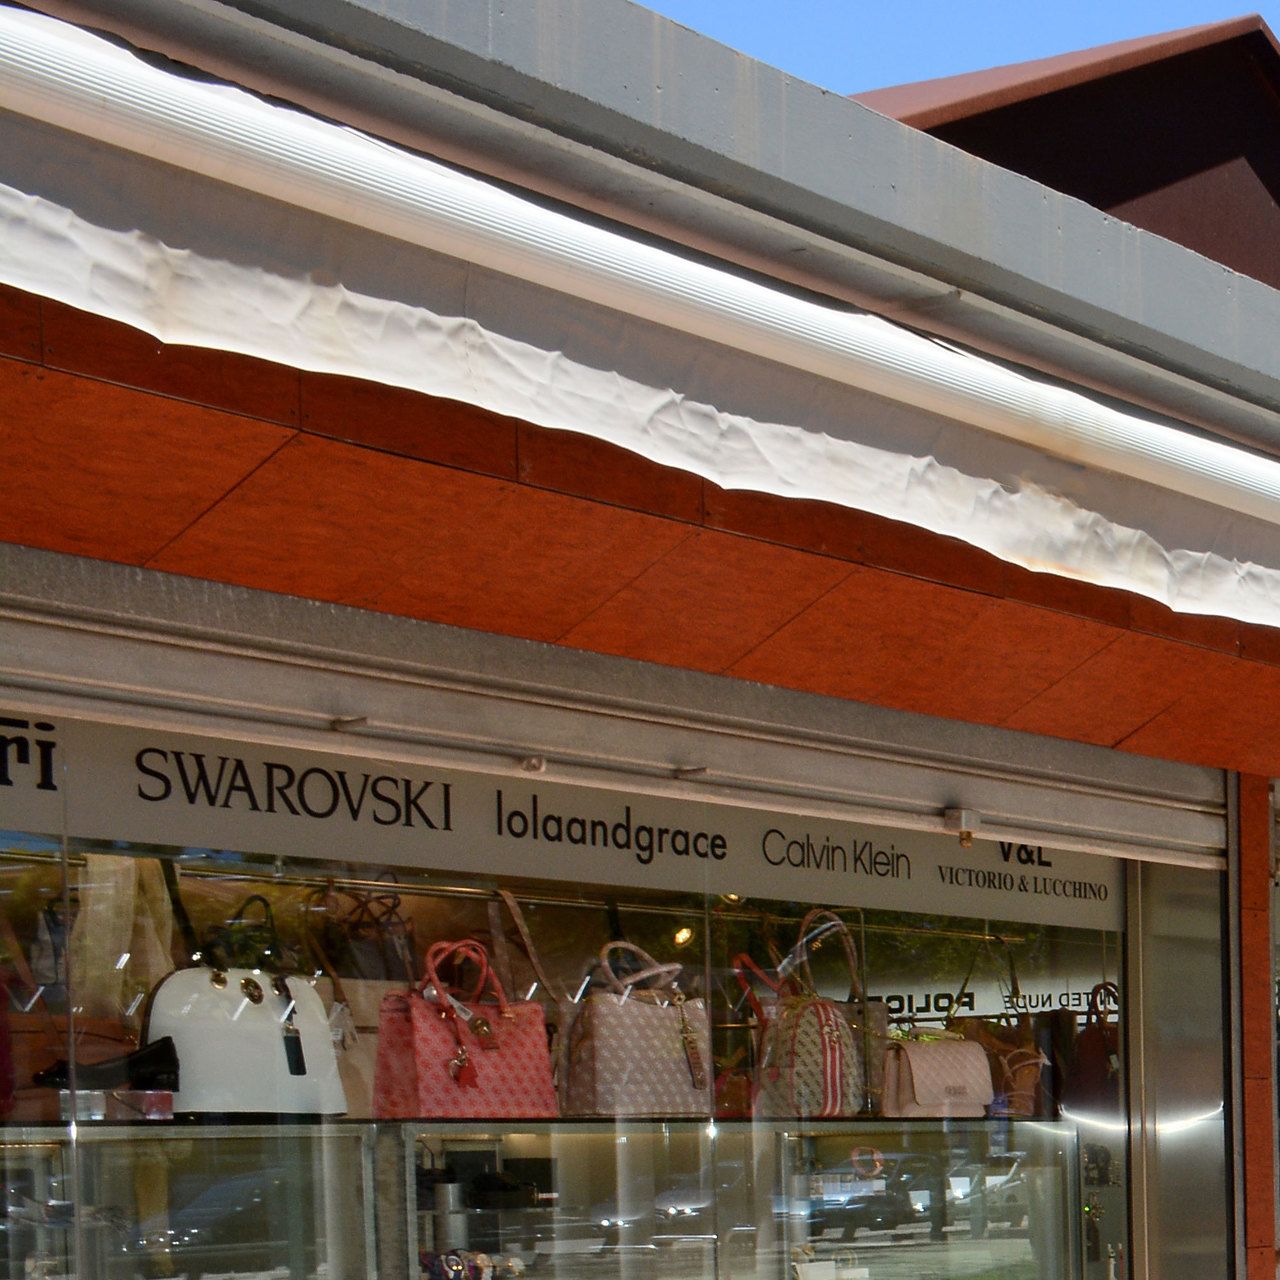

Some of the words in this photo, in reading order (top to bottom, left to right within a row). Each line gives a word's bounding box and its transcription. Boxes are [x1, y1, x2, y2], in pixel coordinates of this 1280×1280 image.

[135, 747, 453, 831] SWAROVSKI
[496, 790, 728, 865] lolaandgrace
[762, 829, 847, 873] Calvin
[853, 840, 912, 880] Klein
[937, 865, 1015, 892] VICTORIO
[1018, 879, 1029, 892] &
[1033, 876, 1109, 901] LUCCHINO
